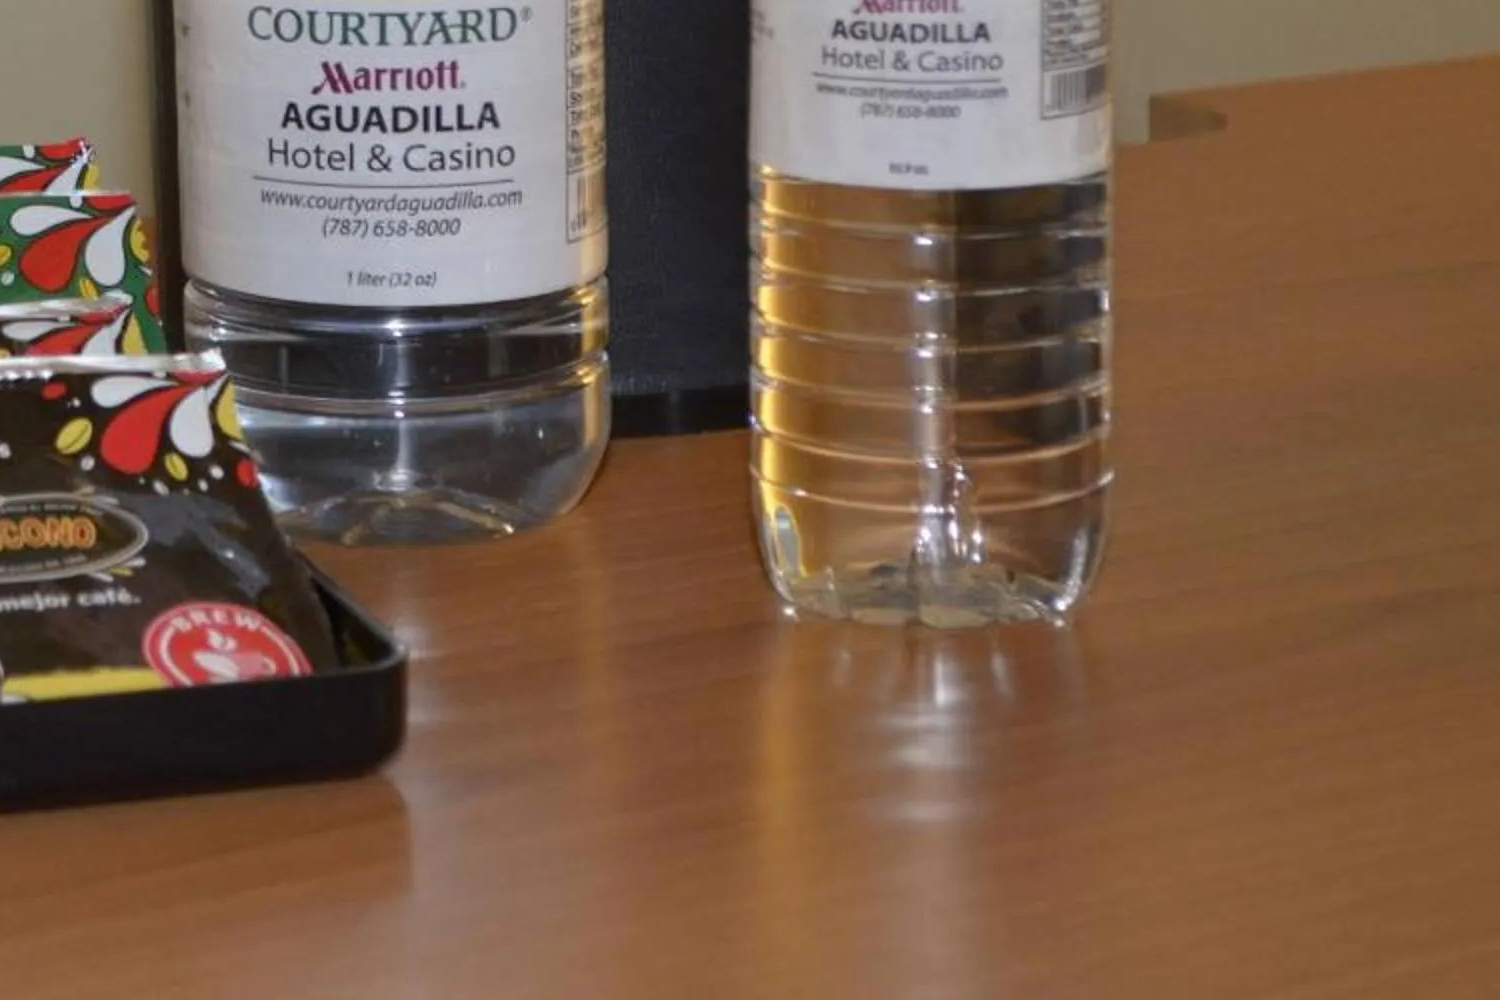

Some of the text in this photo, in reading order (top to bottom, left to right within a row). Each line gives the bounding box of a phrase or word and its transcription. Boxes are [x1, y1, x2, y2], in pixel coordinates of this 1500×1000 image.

[831, 18, 991, 44] AGUADILLA
[821, 46, 1004, 72] Hotel & Casino
[310, 59, 461, 95] Marriott
[280, 102, 501, 133] AGUADILLA
[268, 138, 516, 172] Hotel & Casino
[260, 188, 523, 216] www.courtyardaguadilla.com
[322, 218, 461, 239] (787) 658-8000
[346, 271, 353, 286] 1
[357, 272, 386, 286] liter
[415, 272, 437, 288] oz)
[78, 589, 141, 607] café.
[171, 608, 262, 631] BREW
